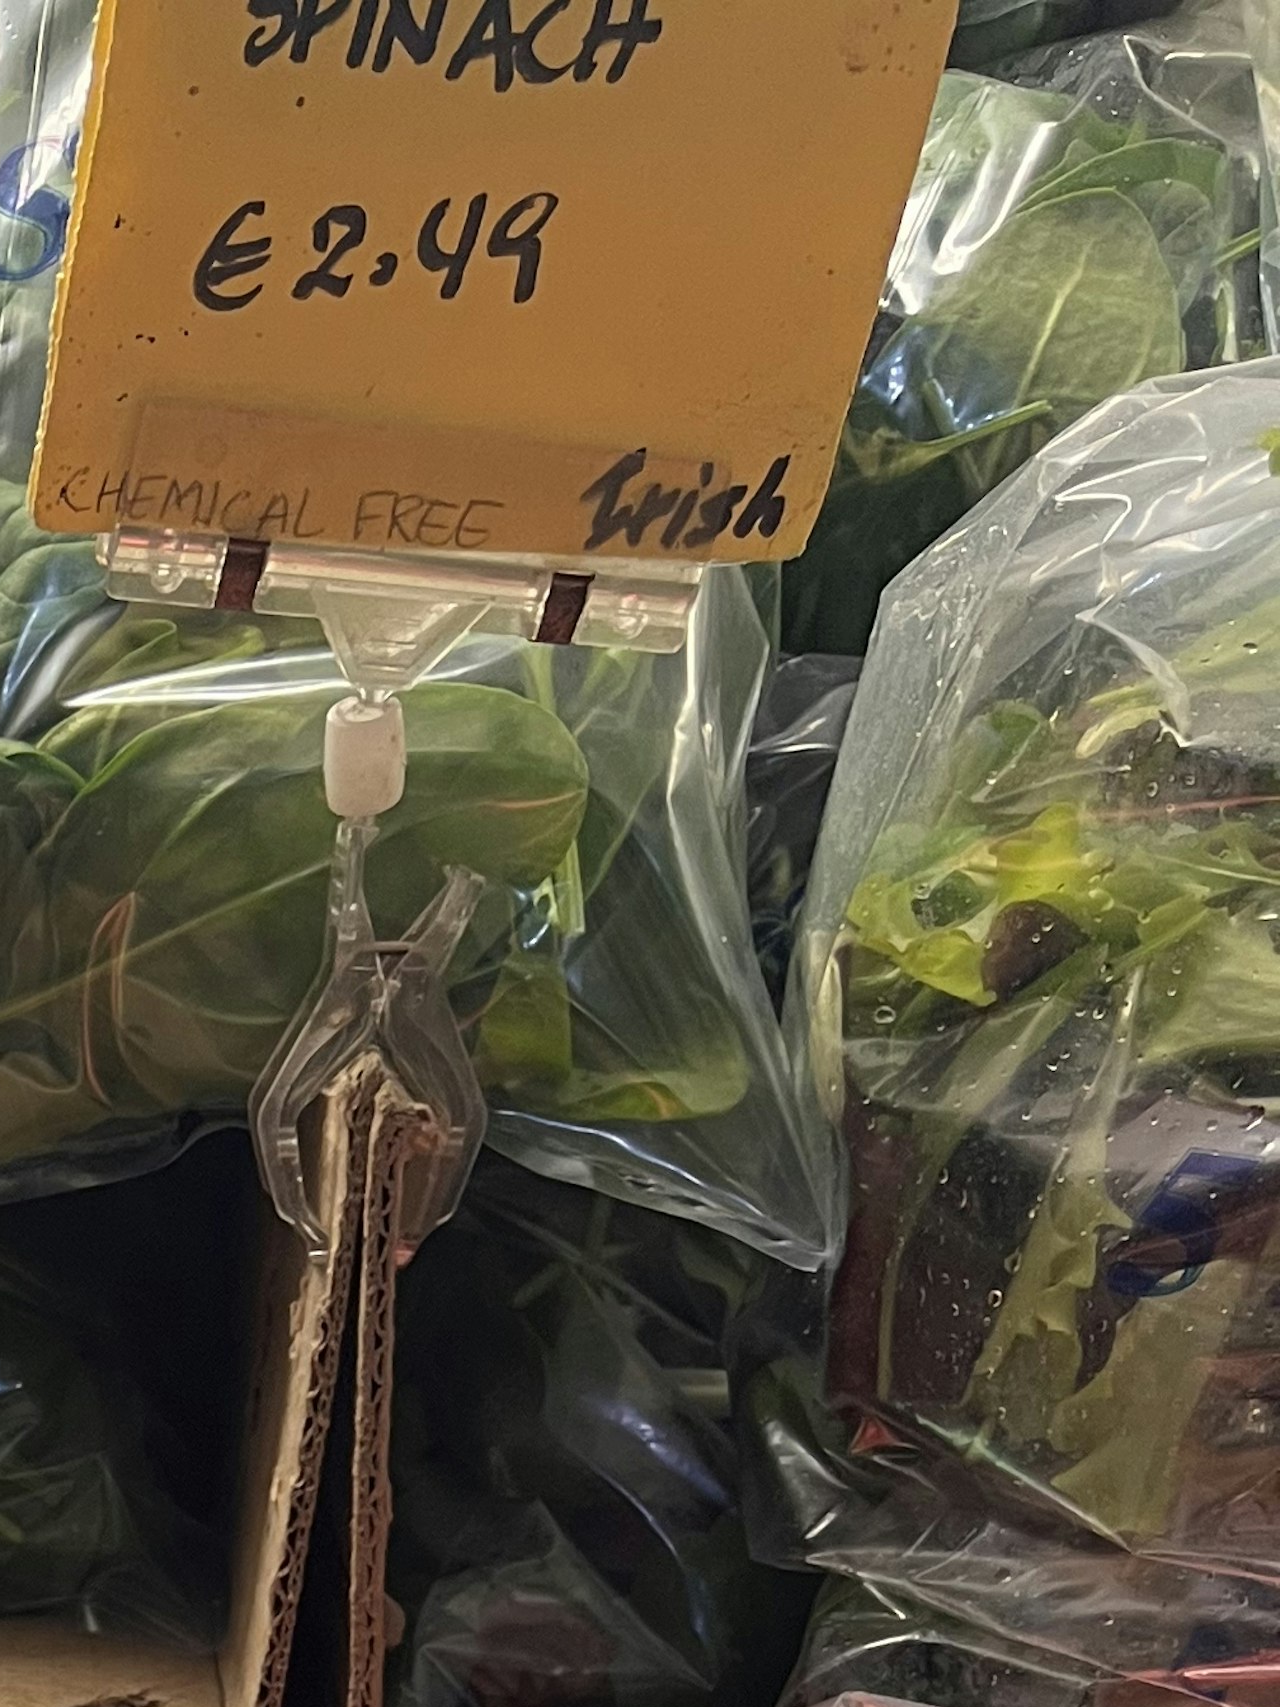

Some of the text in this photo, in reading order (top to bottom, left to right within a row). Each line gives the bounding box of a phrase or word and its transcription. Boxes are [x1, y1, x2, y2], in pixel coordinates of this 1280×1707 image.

[243, 0, 663, 93] SPINACH
[192, 191, 559, 311] €2.49
[56, 446, 792, 551] CHEMICAL FREE Irish
